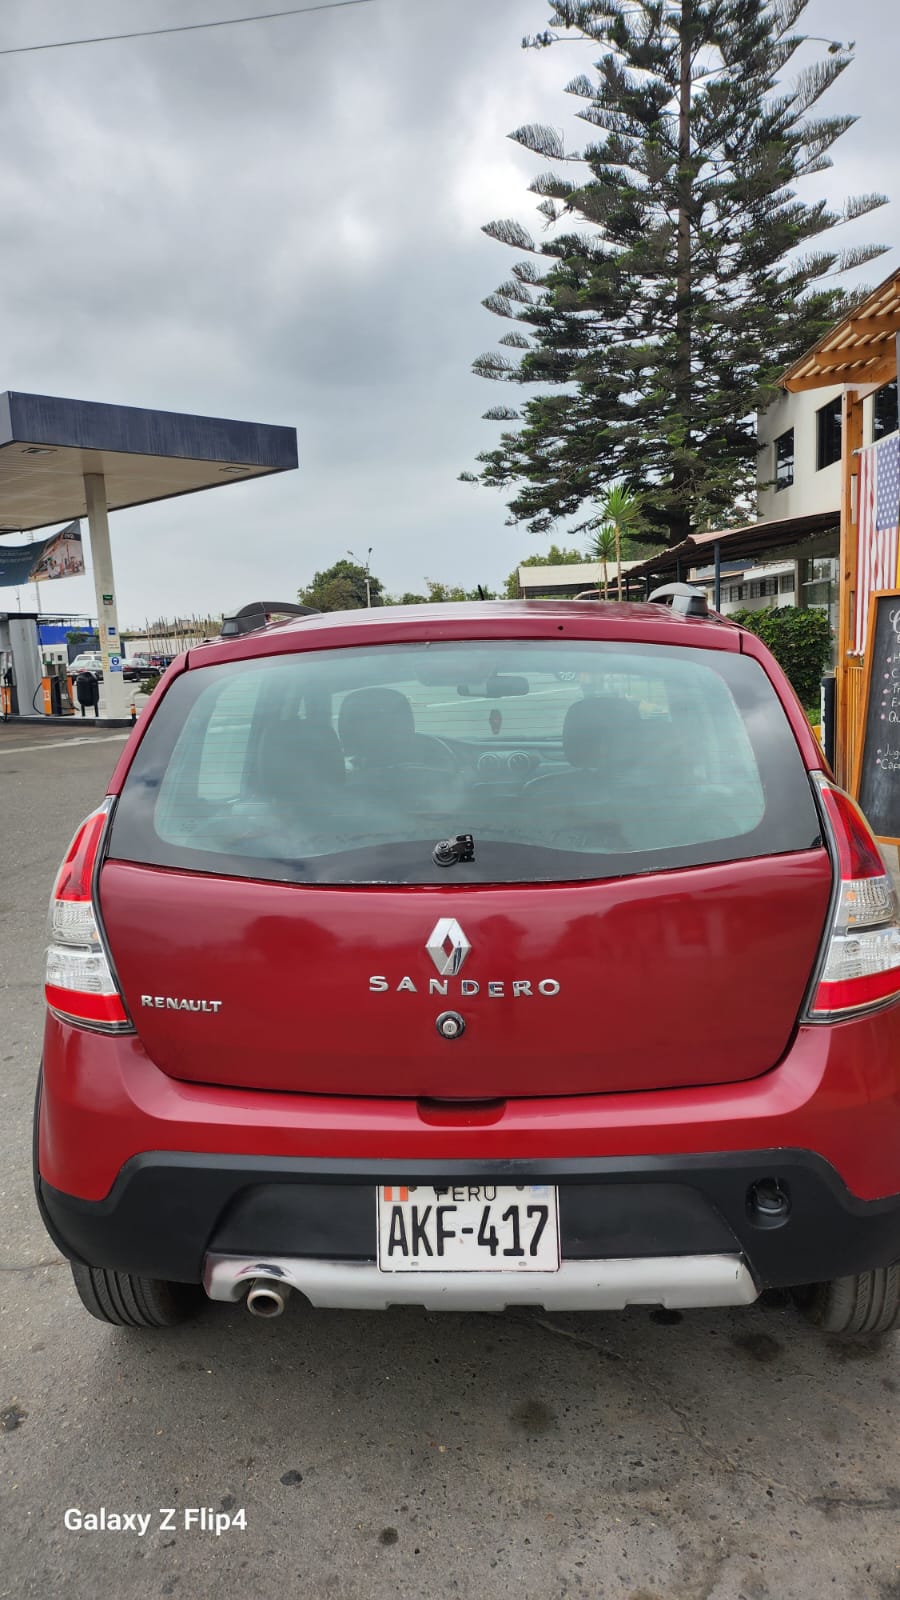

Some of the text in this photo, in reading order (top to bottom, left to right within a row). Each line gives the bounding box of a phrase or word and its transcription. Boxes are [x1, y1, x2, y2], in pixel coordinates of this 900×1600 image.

[369, 976, 560, 997] SANDERO
[141, 995, 222, 1012] RENAULT
[388, 1205, 549, 1256] AKF-417
